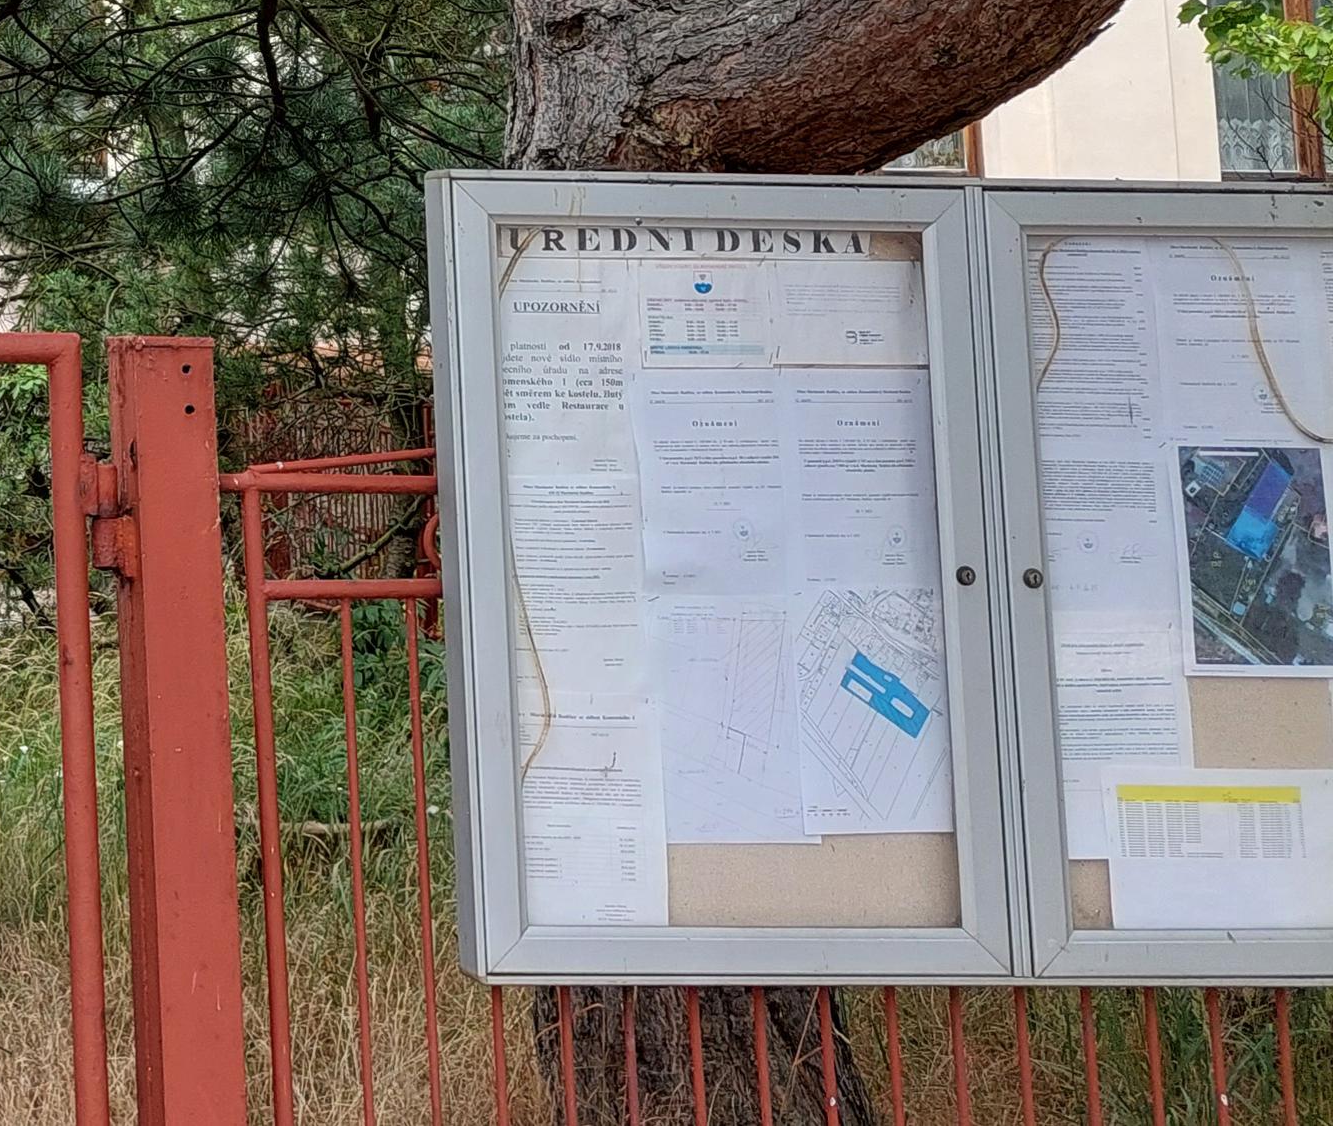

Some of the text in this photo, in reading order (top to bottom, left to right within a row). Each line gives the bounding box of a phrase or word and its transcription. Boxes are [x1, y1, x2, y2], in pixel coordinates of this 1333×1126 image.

[715, 228, 865, 255] DESKA
[513, 299, 601, 312] UPOZORNĚNÍ
[510, 341, 547, 352] platnosti
[558, 342, 570, 351] od
[501, 354, 524, 364] jdete
[501, 364, 533, 374] ecního
[578, 367, 589, 375] na
[502, 377, 553, 386] omenského
[554, 389, 566, 398] ke
[561, 401, 609, 411] Restaurace
